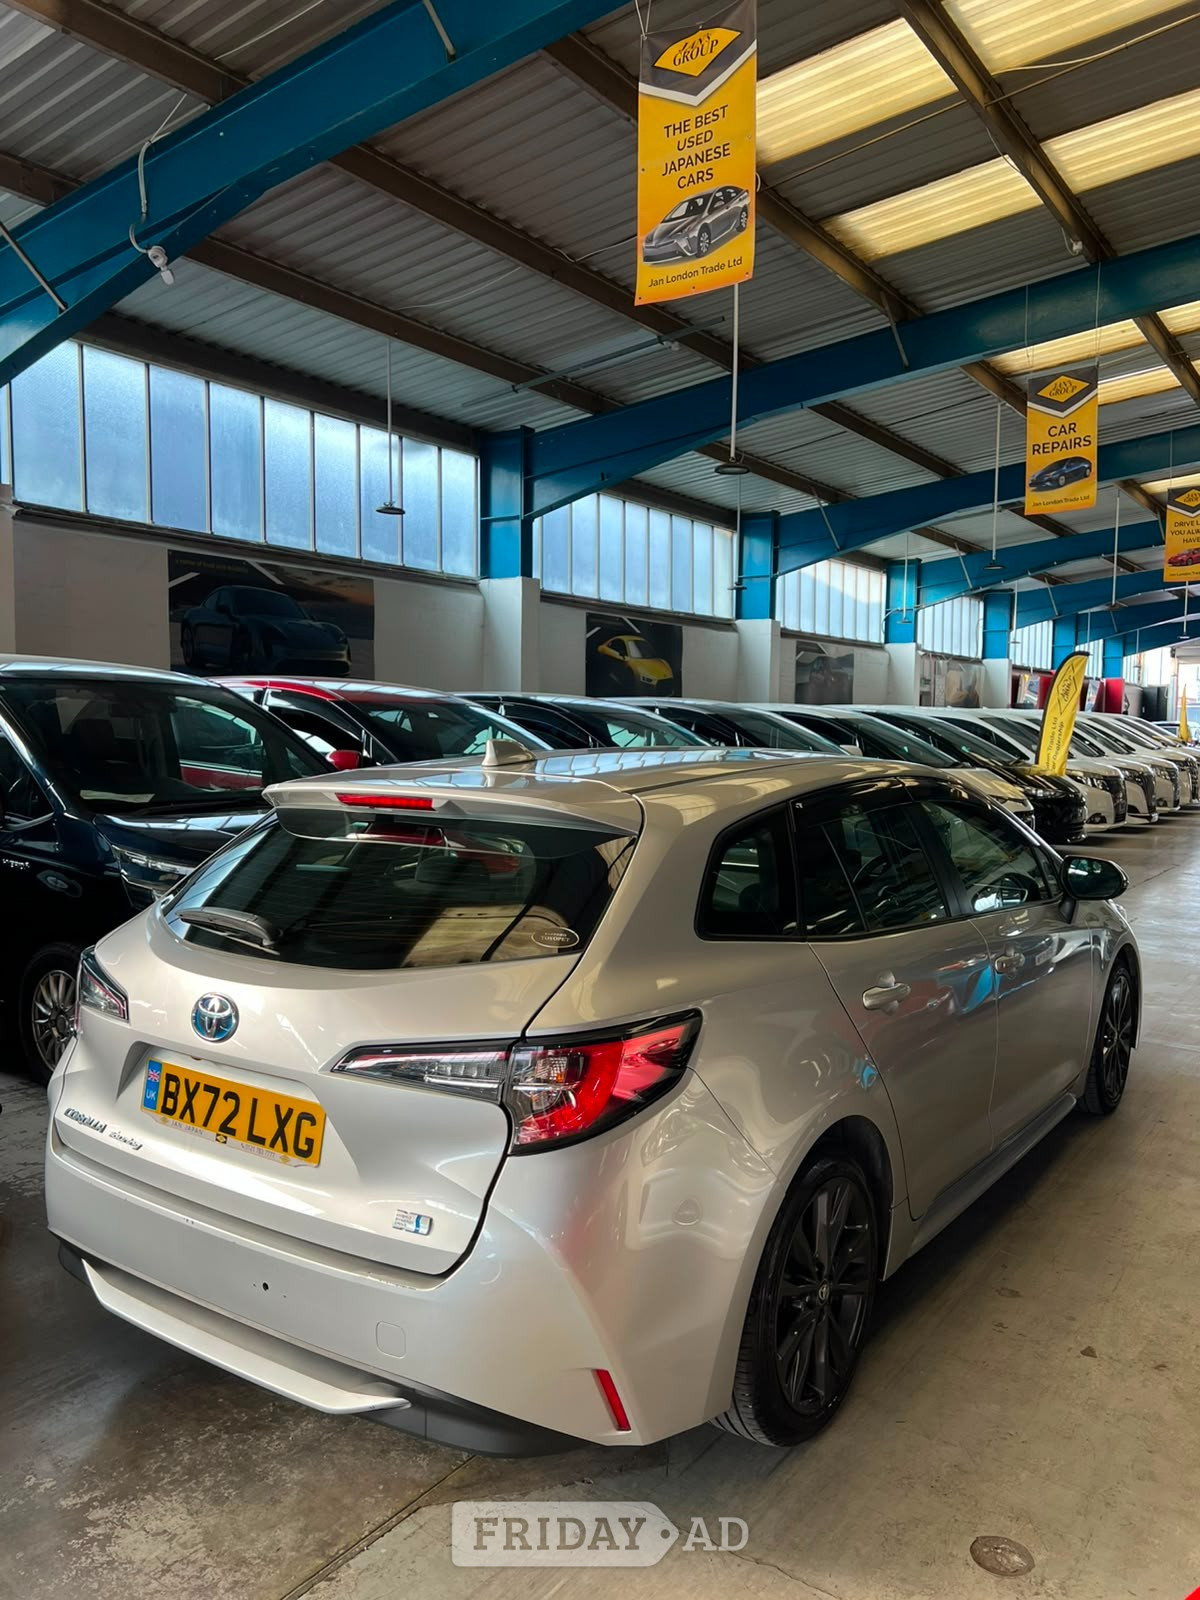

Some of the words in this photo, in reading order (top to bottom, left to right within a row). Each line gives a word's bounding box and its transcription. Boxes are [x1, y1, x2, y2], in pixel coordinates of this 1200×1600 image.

[673, 39, 719, 66] GROUP
[664, 118, 691, 138] THE
[695, 105, 728, 129] BEST
[677, 130, 713, 151] USED
[662, 142, 730, 176] JAPANESE
[677, 168, 714, 189] CARS
[648, 278, 664, 287] Jan
[666, 270, 699, 284] London
[700, 263, 726, 274] Trade
[728, 256, 743, 268] Ltd
[1049, 385, 1077, 398] GROUP
[1048, 422, 1077, 437] CAR
[1032, 435, 1092, 455] REPAIRS
[1174, 520, 1194, 528] DRIVE
[145, 1090, 156, 1100] UK
[161, 1072, 240, 1137] BX72
[246, 1097, 316, 1159] LXG
[170, 1120, 183, 1130] JAN
[184, 1124, 204, 1136] JAPAN
